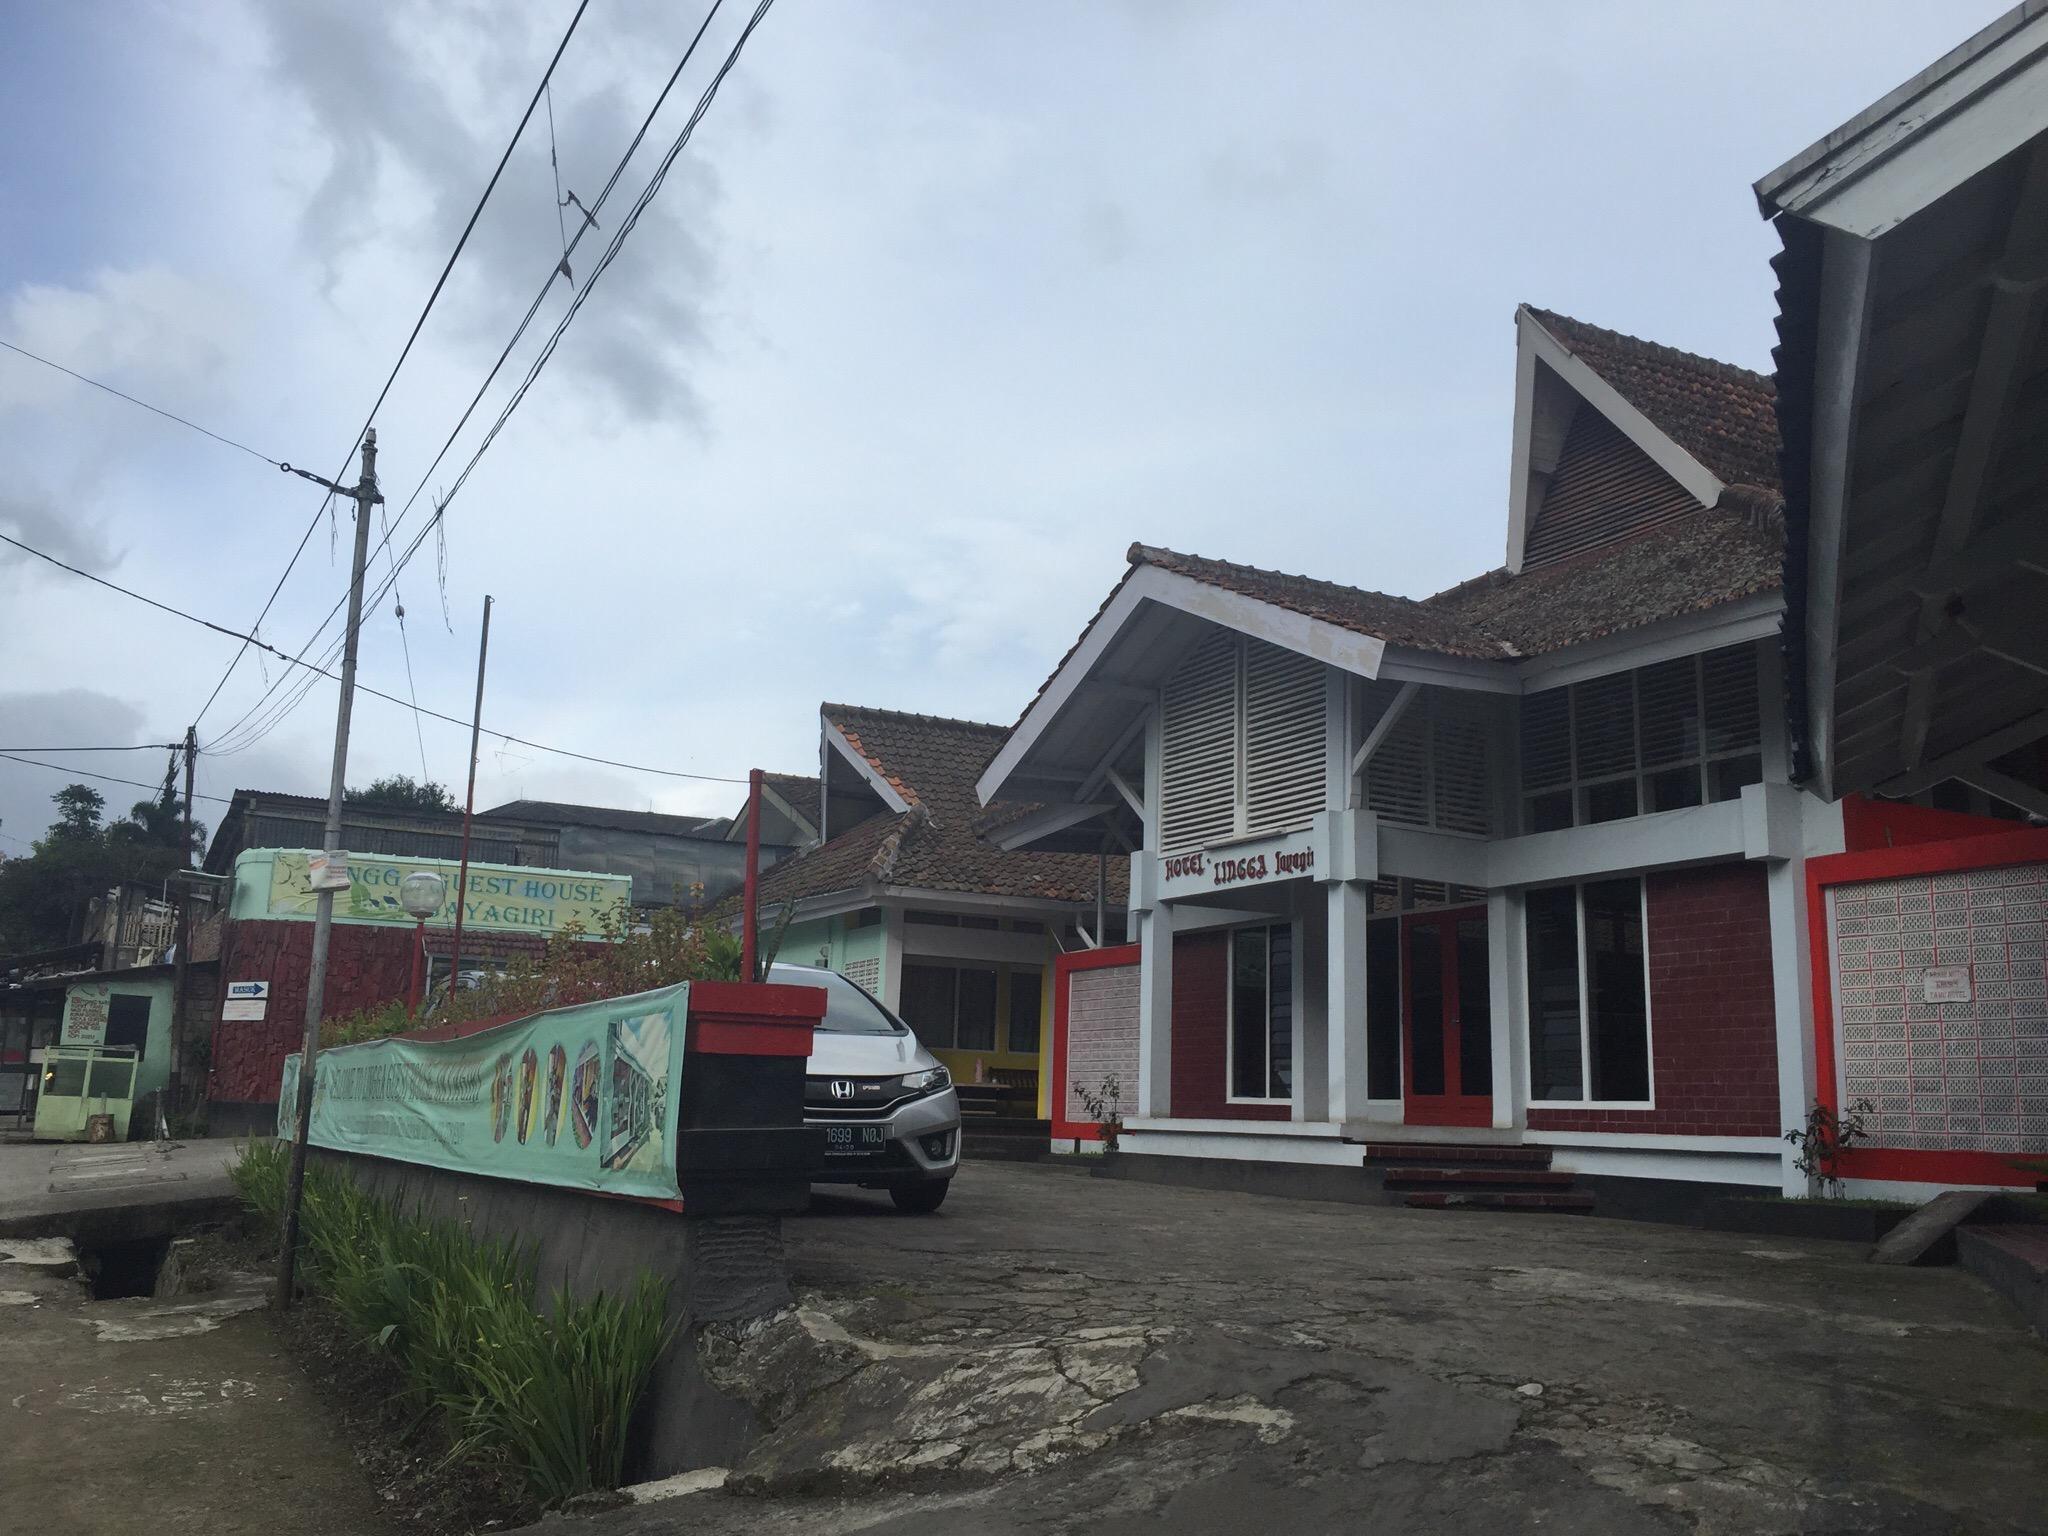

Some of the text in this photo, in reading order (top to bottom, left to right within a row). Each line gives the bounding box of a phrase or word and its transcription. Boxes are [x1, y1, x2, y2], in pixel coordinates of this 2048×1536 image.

[1165, 853, 1205, 881] HOTEL
[1214, 854, 1268, 885] LINGGA
[524, 880, 604, 902] HOUSE
[434, 901, 555, 927] AYAGIRI
[826, 1127, 852, 1142] 1699
